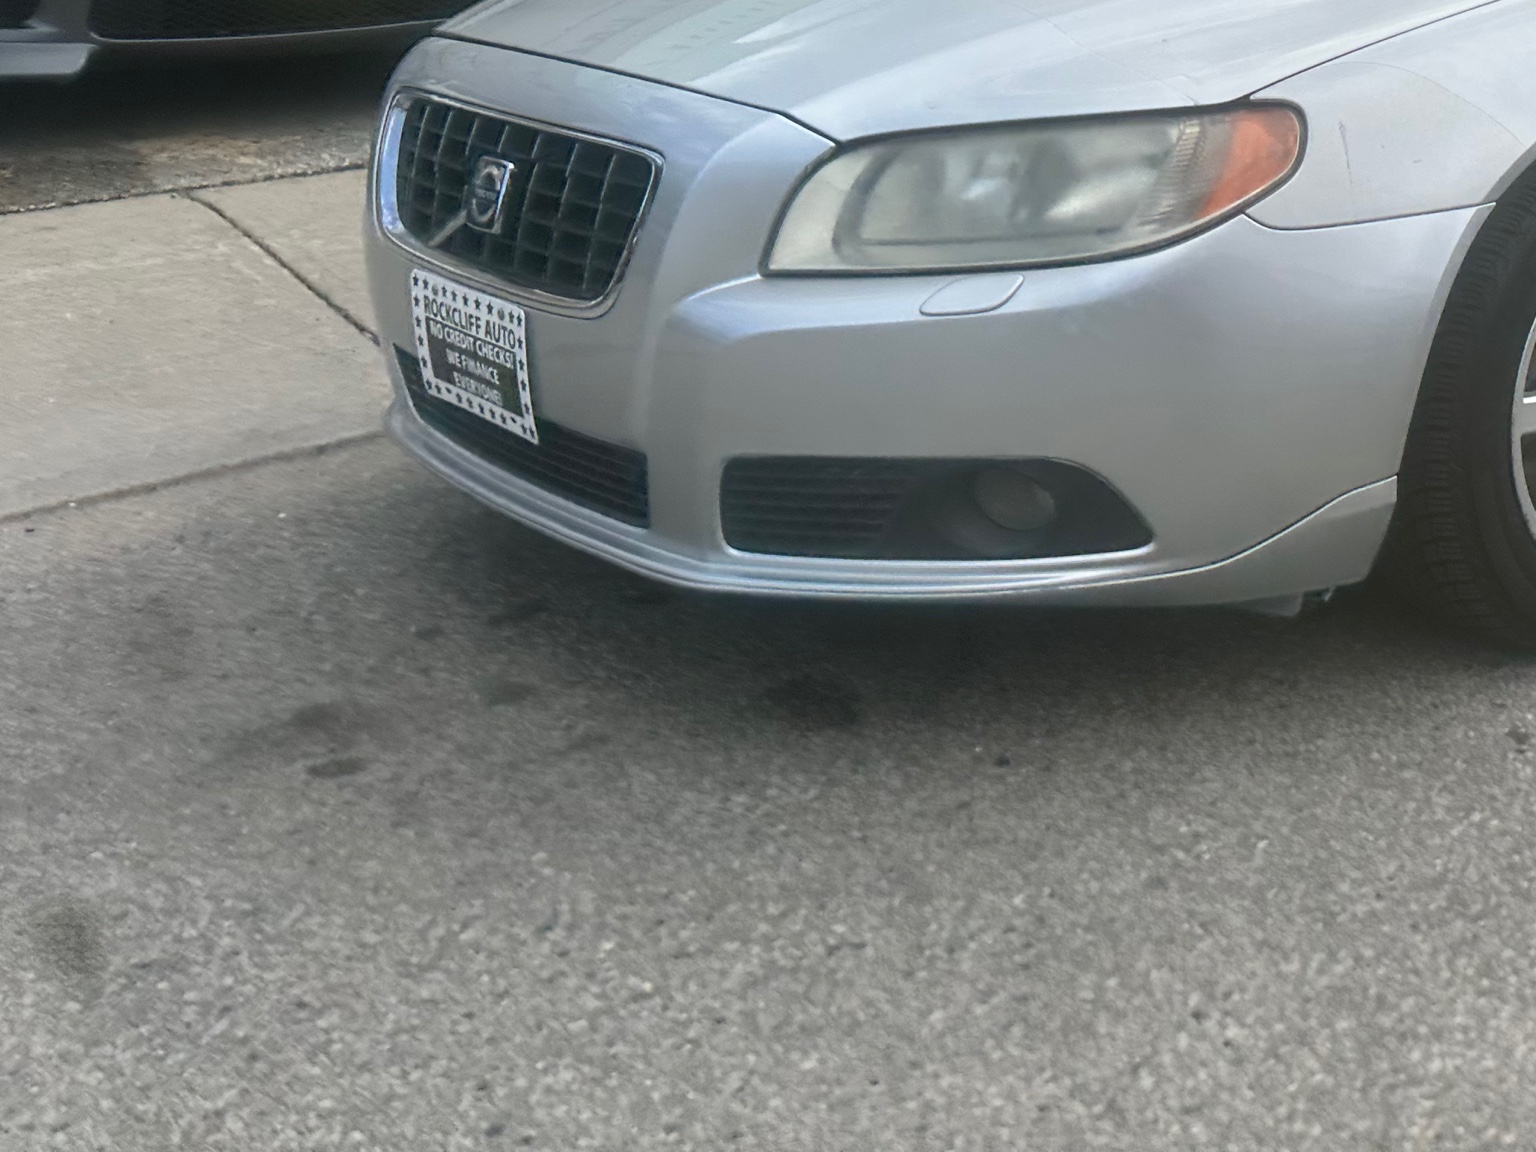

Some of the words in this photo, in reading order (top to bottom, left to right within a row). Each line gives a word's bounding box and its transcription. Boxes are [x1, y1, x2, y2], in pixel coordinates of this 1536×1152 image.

[424, 295, 482, 335] ROCKCLIFF
[484, 319, 516, 349] AUTO
[430, 320, 443, 340] NO
[444, 326, 475, 351] CREDIT
